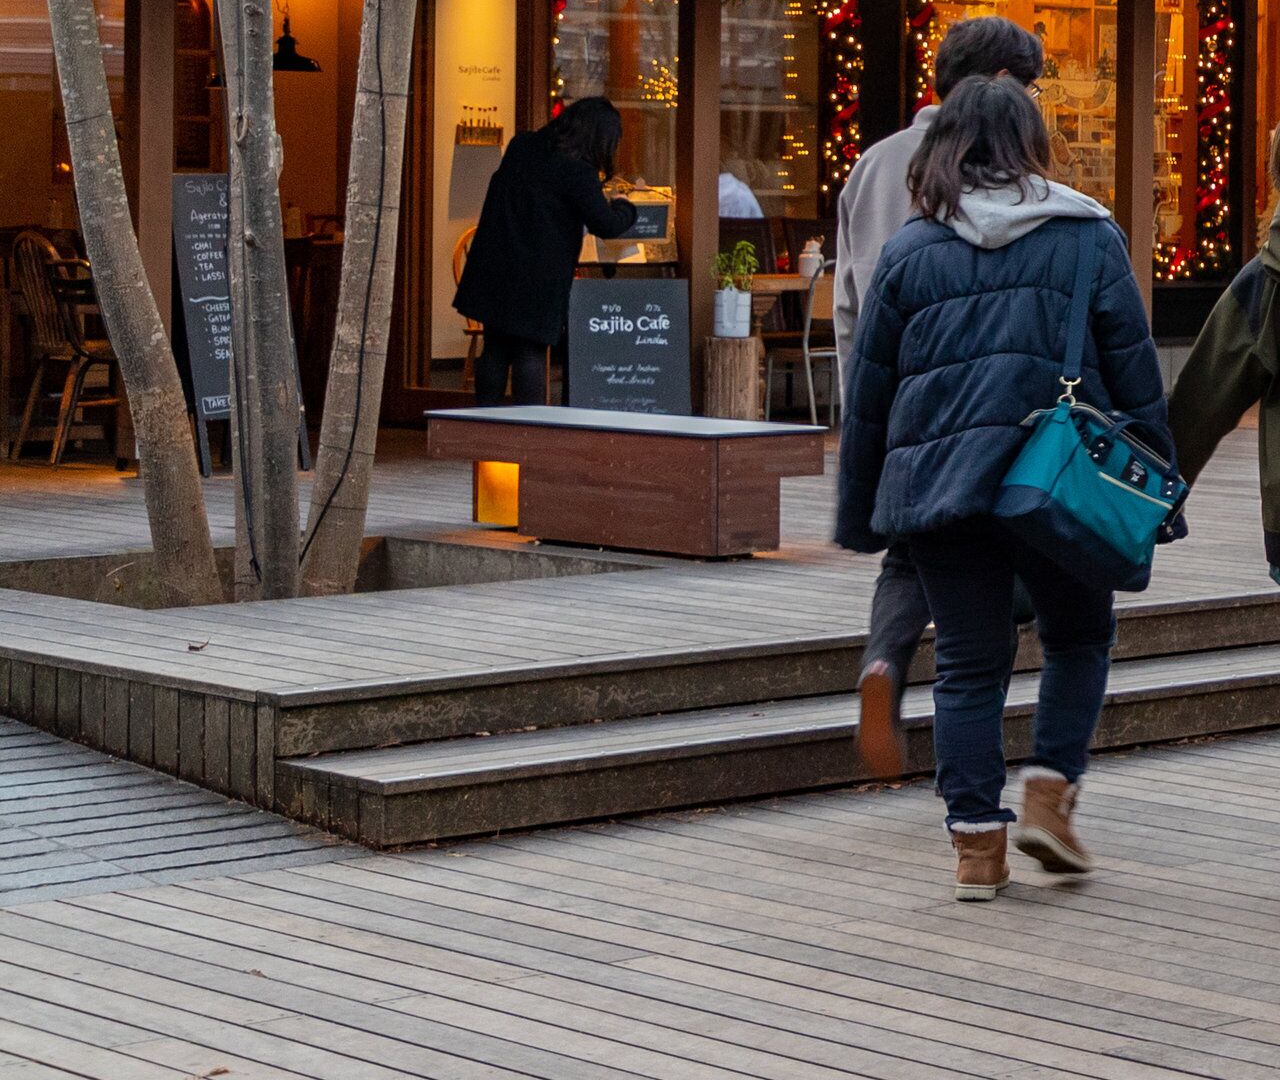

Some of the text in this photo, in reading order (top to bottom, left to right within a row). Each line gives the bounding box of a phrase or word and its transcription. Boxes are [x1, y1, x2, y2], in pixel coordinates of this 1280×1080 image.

[190, 209, 228, 224] Ageratu
[196, 251, 224, 261] COFFEE
[199, 263, 214, 271] TEA
[201, 272, 226, 282] LASSI
[589, 316, 634, 334] Sajilo
